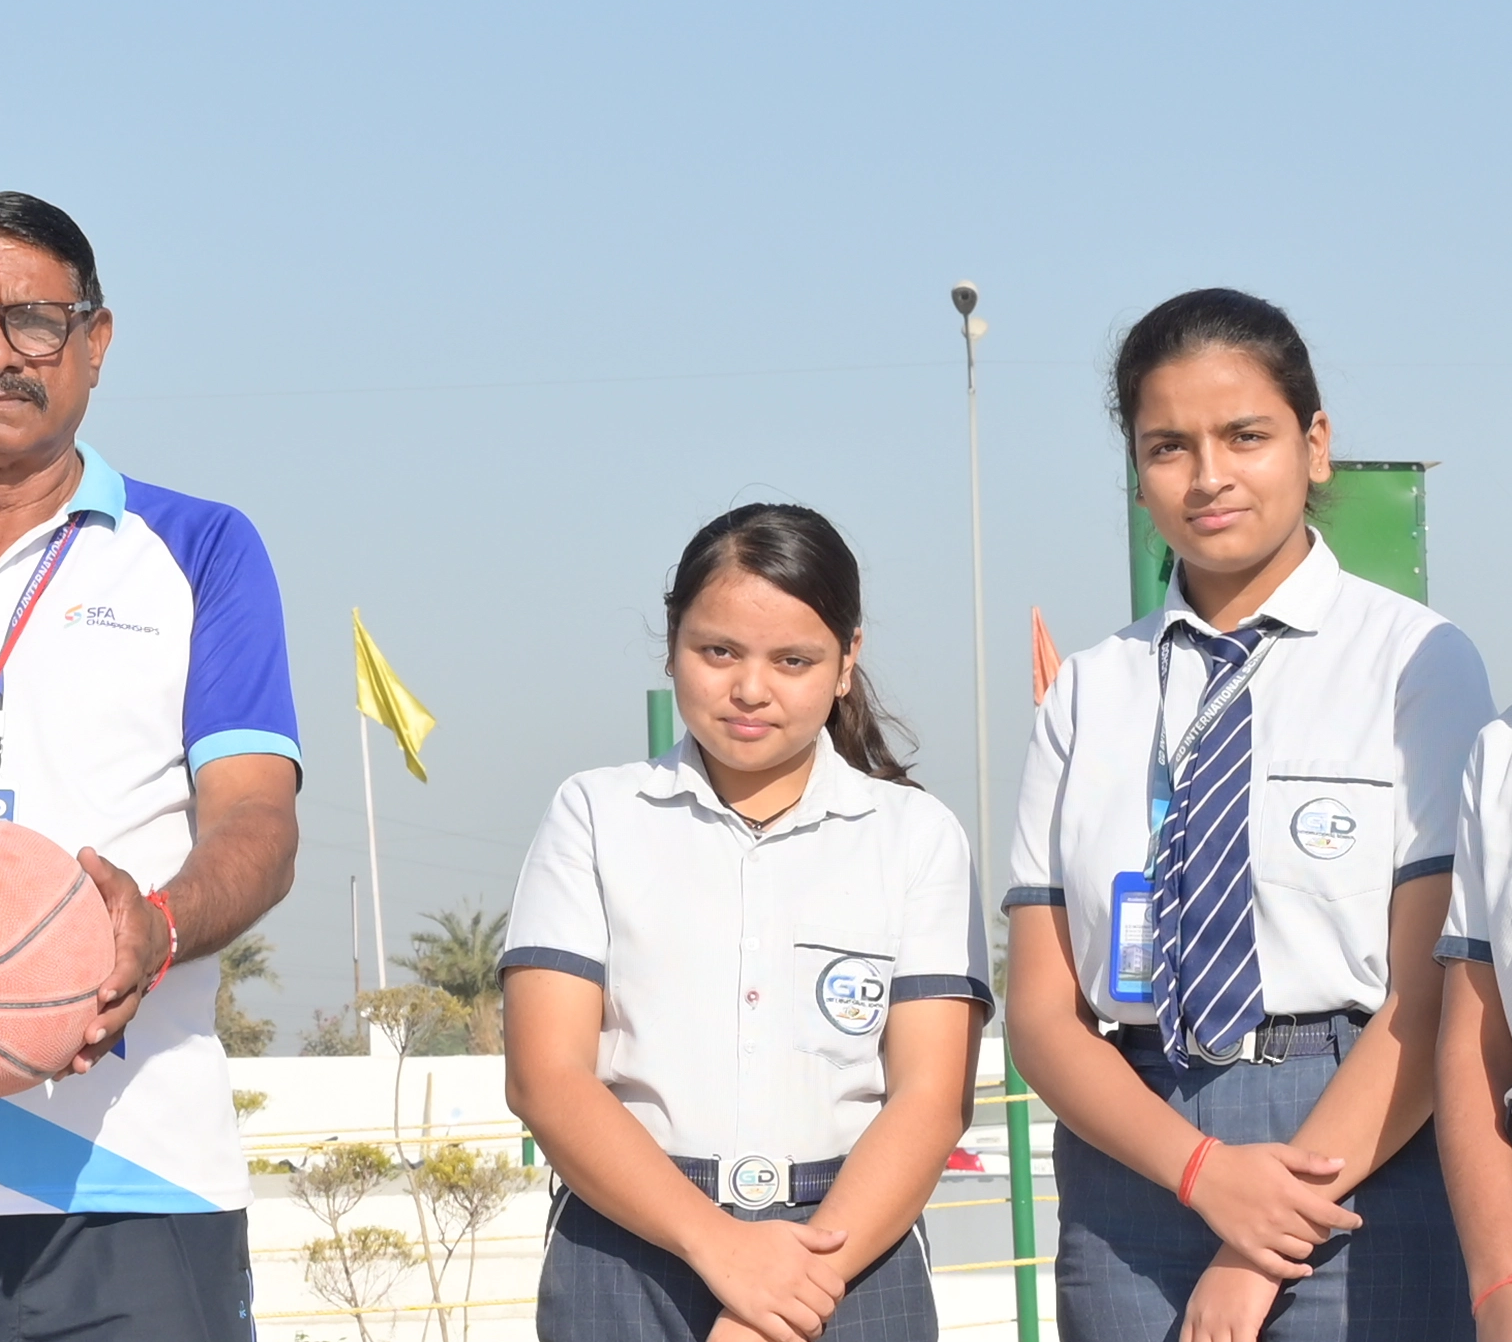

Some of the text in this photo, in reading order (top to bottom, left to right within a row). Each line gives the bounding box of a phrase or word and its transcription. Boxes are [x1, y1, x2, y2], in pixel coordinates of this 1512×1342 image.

[87, 607, 115, 620] SFA
[1185, 673, 1246, 747] INTERNATIONAL
[1301, 812, 1356, 834] GD
[828, 975, 885, 1002] GD
[739, 1170, 775, 1183] GD
